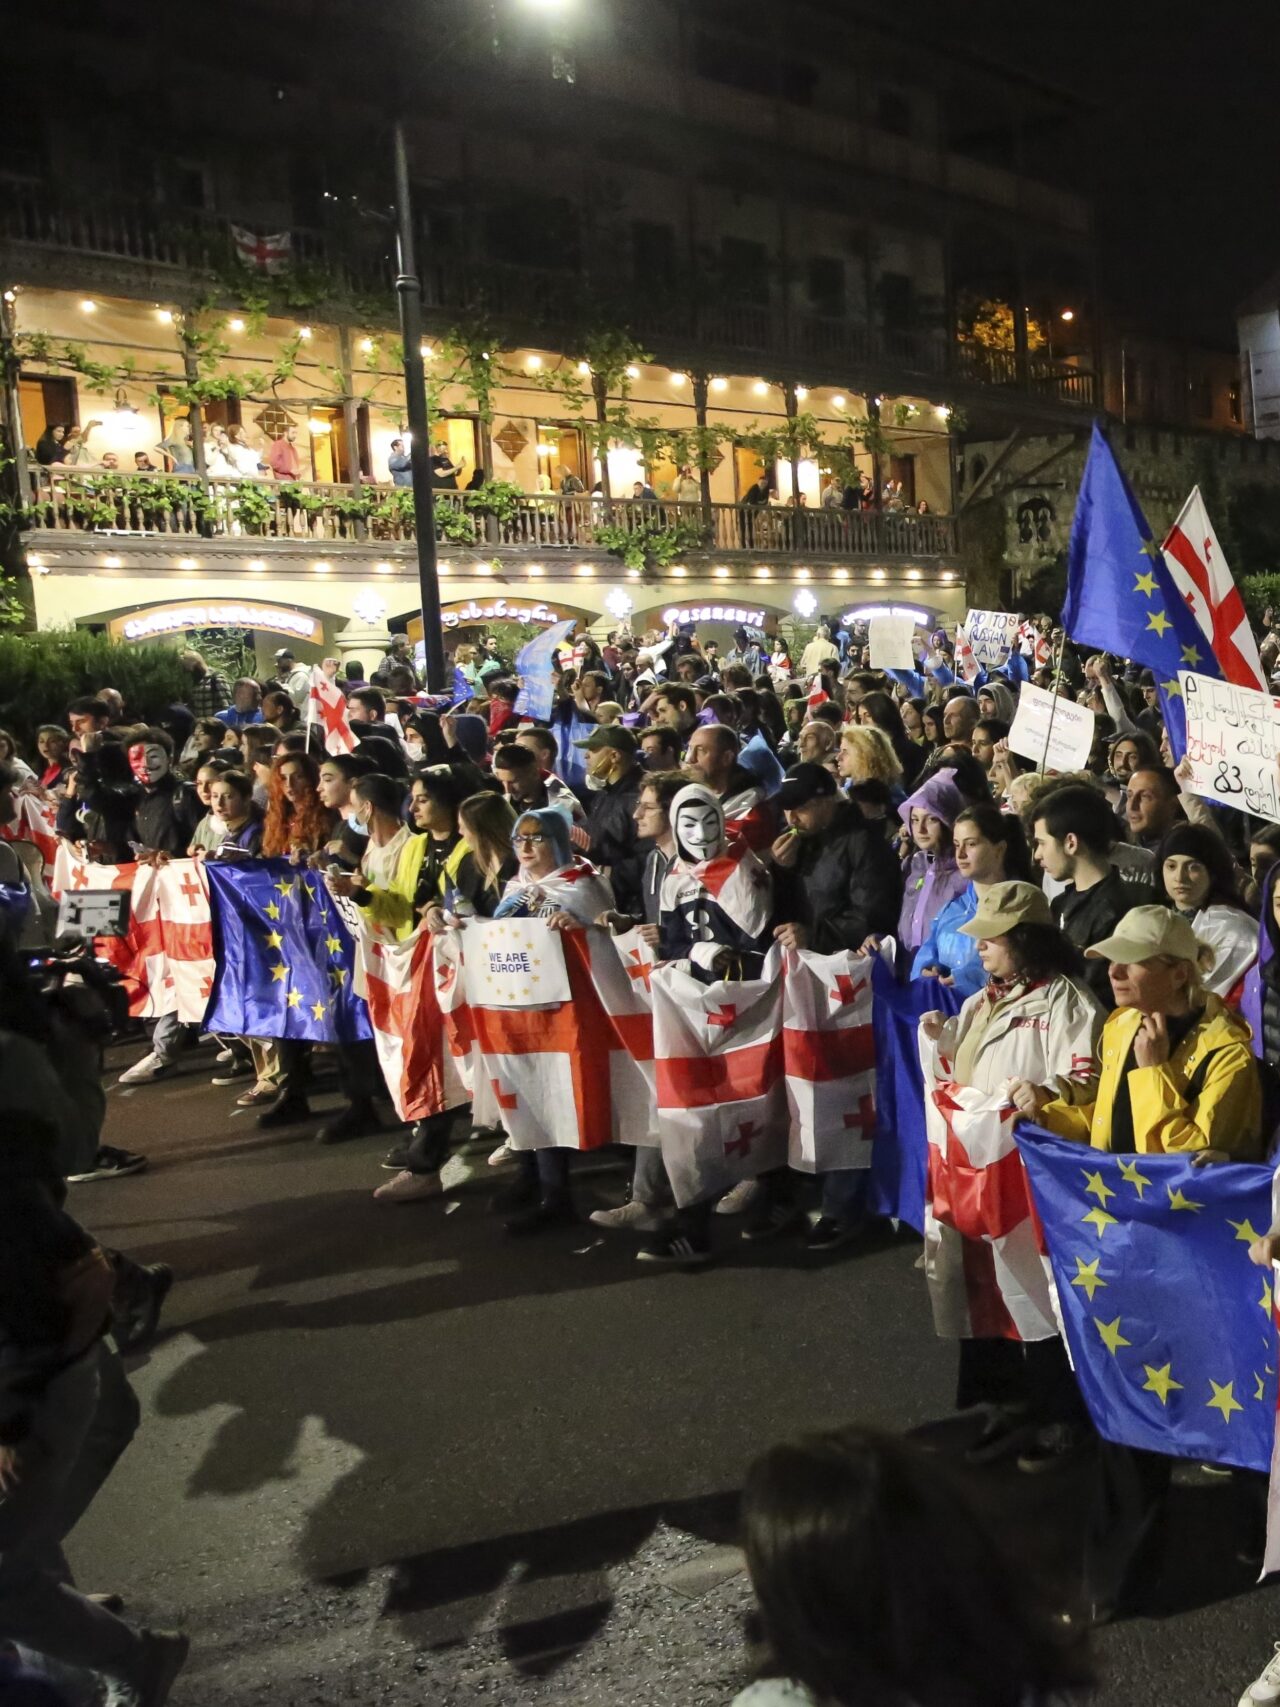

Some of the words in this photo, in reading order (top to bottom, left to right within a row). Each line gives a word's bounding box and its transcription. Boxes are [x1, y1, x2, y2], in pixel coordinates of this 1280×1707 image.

[440, 600, 558, 626] ფასანაური
[970, 611, 986, 625] NO
[992, 614, 1008, 629] TO
[971, 644, 1000, 659] LAW
[489, 952, 503, 963] WE
[505, 952, 529, 963] ARE
[490, 963, 532, 973] EUROPE
